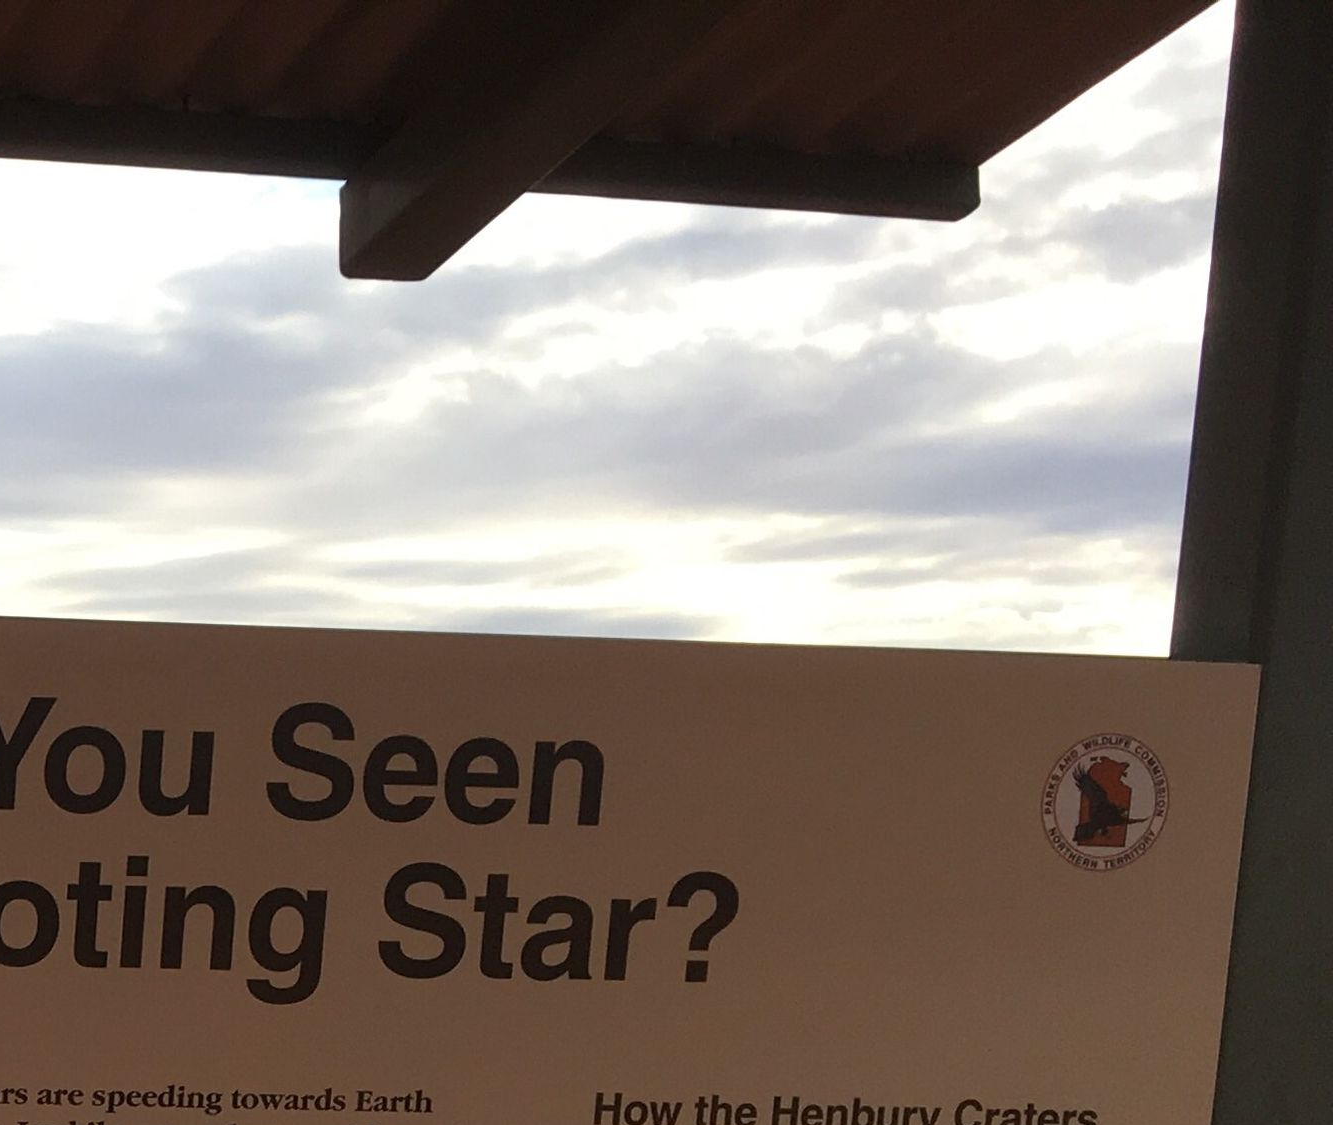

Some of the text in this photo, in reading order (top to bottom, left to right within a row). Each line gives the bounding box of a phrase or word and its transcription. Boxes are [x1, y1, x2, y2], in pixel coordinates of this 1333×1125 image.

[266, 703, 604, 826] Seen
[378, 862, 739, 982] Star?
[37, 1089, 83, 1105] are
[92, 1085, 222, 1115] speeding
[232, 1088, 345, 1111] towards
[355, 1090, 432, 1113] Earth
